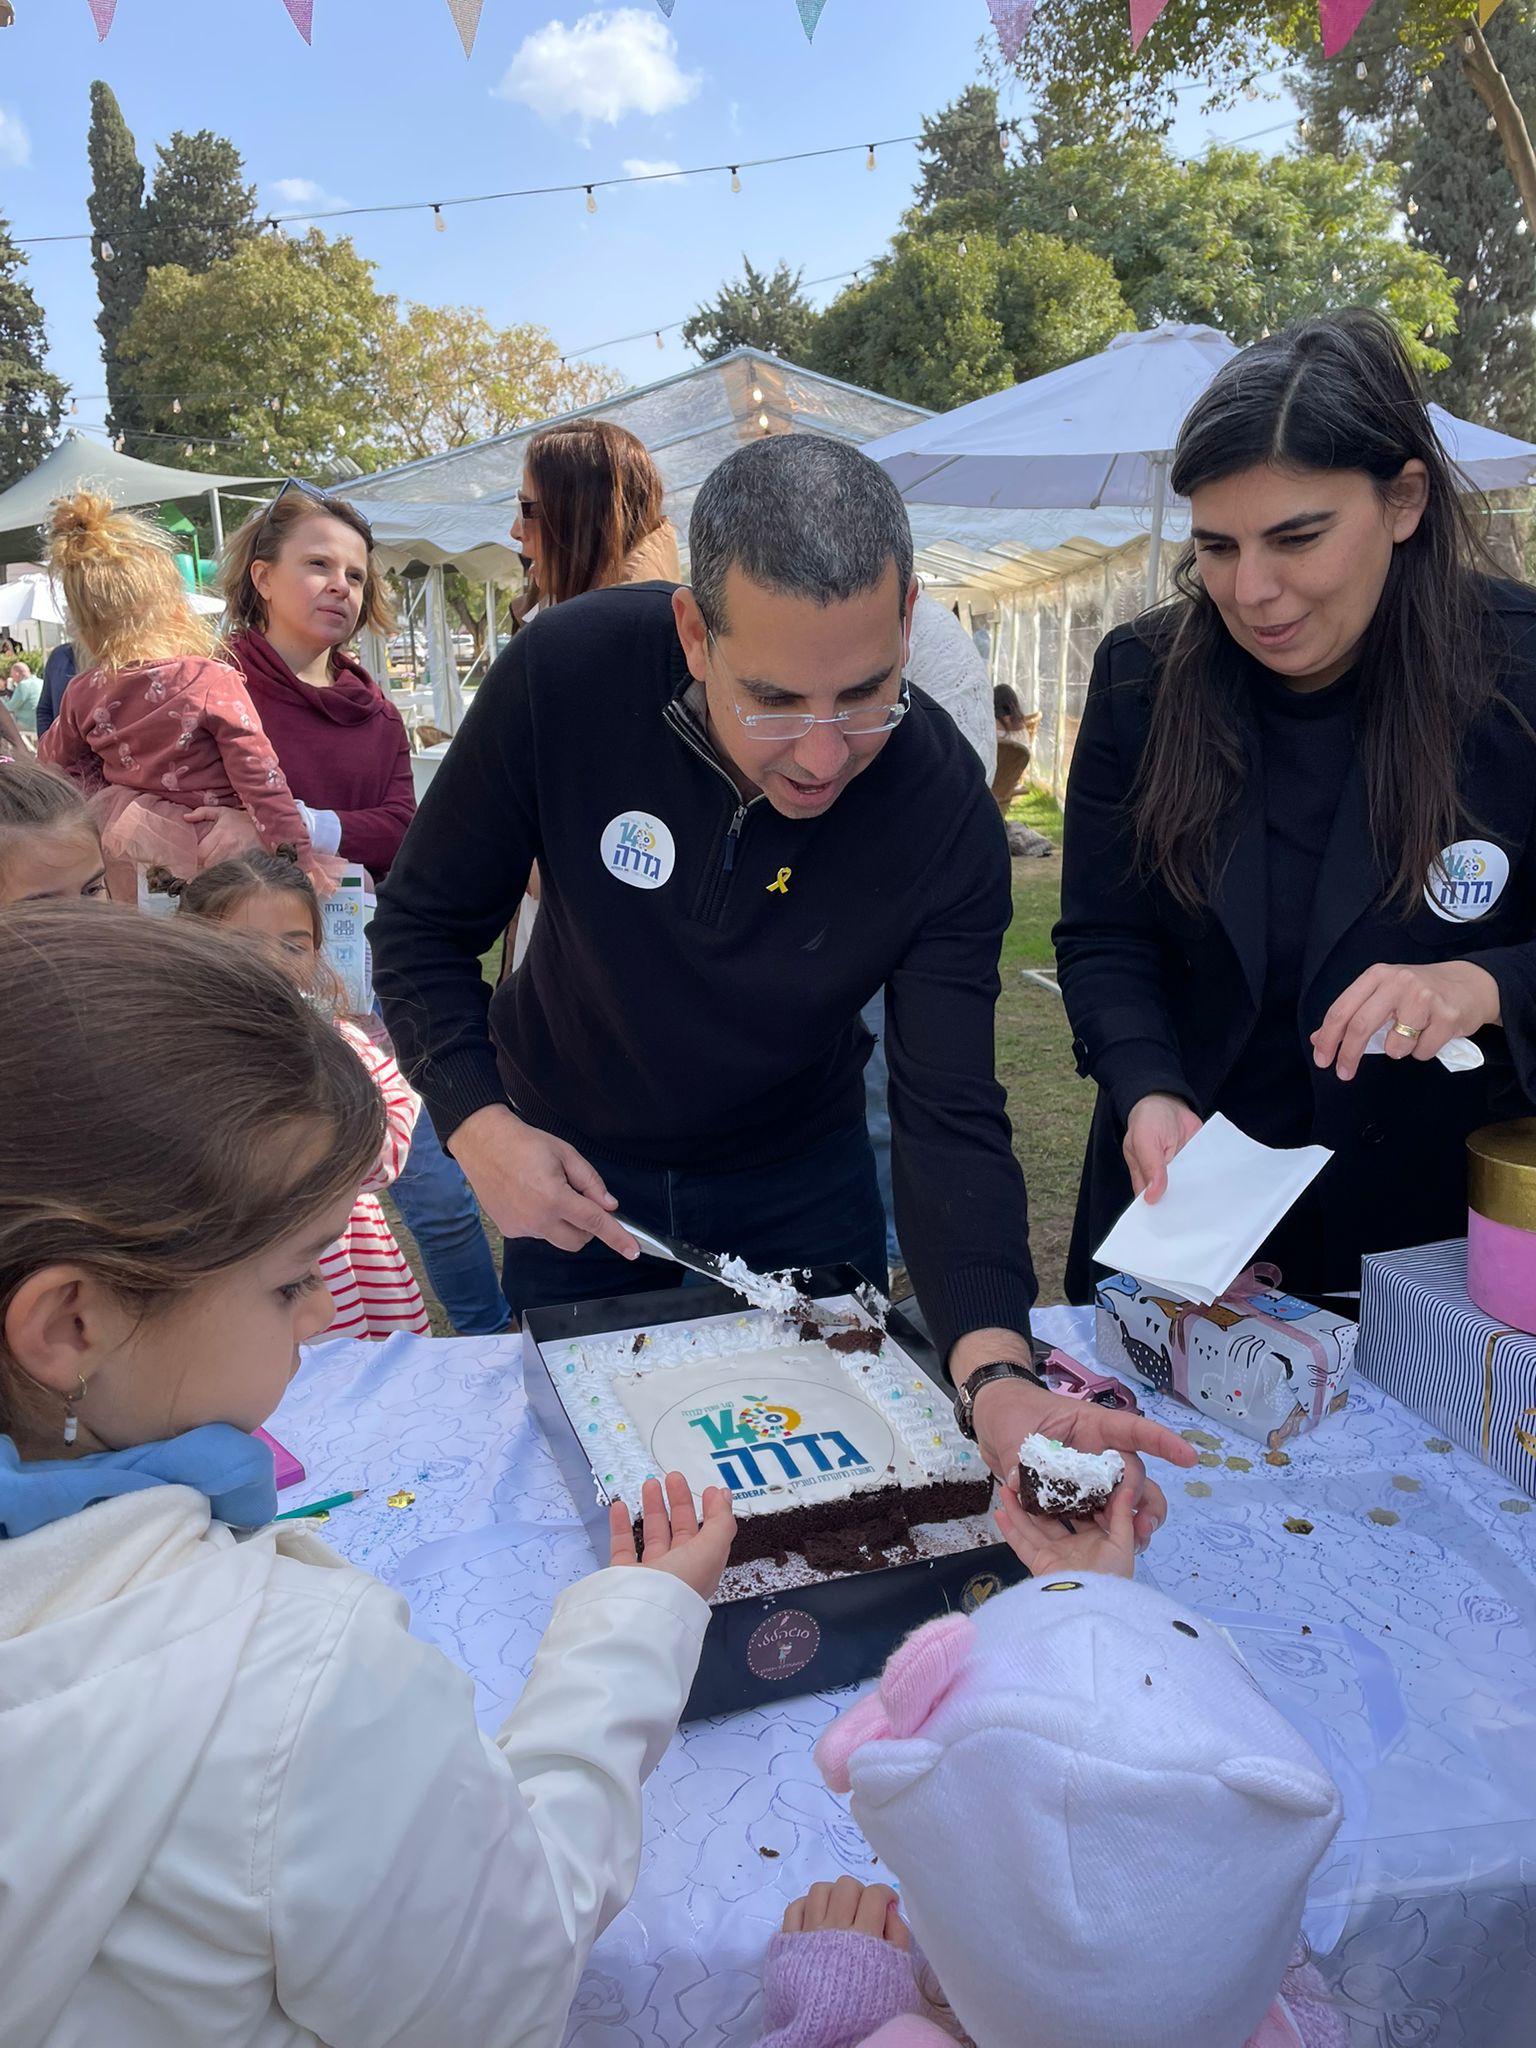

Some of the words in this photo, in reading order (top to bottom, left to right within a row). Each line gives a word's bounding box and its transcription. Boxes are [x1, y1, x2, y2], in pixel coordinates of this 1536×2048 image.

[613, 843, 662, 880] גדרה
[1440, 881, 1493, 904] גדרה
[710, 1430, 869, 1490] גדרה
